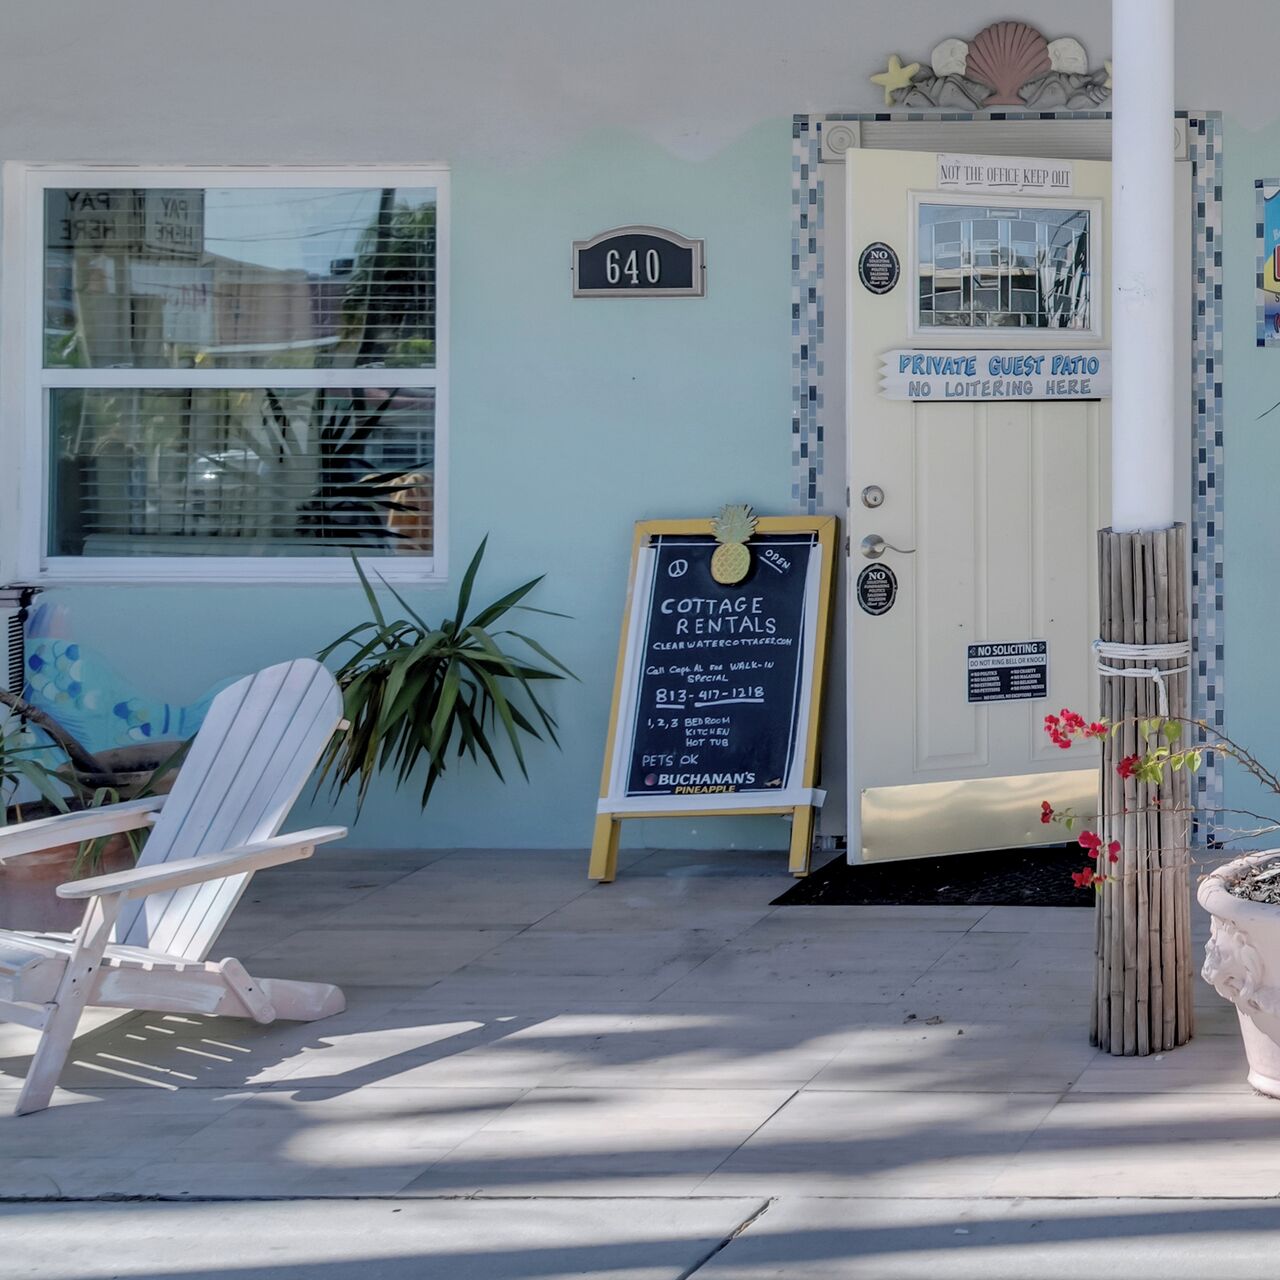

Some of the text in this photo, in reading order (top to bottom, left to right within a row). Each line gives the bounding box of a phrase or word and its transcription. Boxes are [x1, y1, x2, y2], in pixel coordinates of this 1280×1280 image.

[941, 164, 1071, 186] NOT THE OFFICE KEEP OUT
[871, 251, 888, 259] NO
[606, 249, 660, 284] 640
[899, 354, 1100, 376] PRIVATE GUEST PATIO
[908, 378, 1091, 397] NO LOITERING HERE
[765, 549, 791, 569] OPEN
[869, 572, 886, 580] NO
[661, 597, 763, 614] COTTAGE
[676, 616, 776, 635] RENTALS
[978, 643, 1038, 656] NO SOLICITING
[646, 666, 665, 675] Call
[688, 674, 728, 683] SPECIAL
[685, 716, 730, 727] BEDROOM
[685, 728, 730, 736] KITCHEN
[686, 738, 728, 747] HOT TUB
[642, 754, 699, 767] PETS OK
[658, 772, 756, 786] BUCHANAN'S
[674, 785, 736, 794] PINEAPPLE
